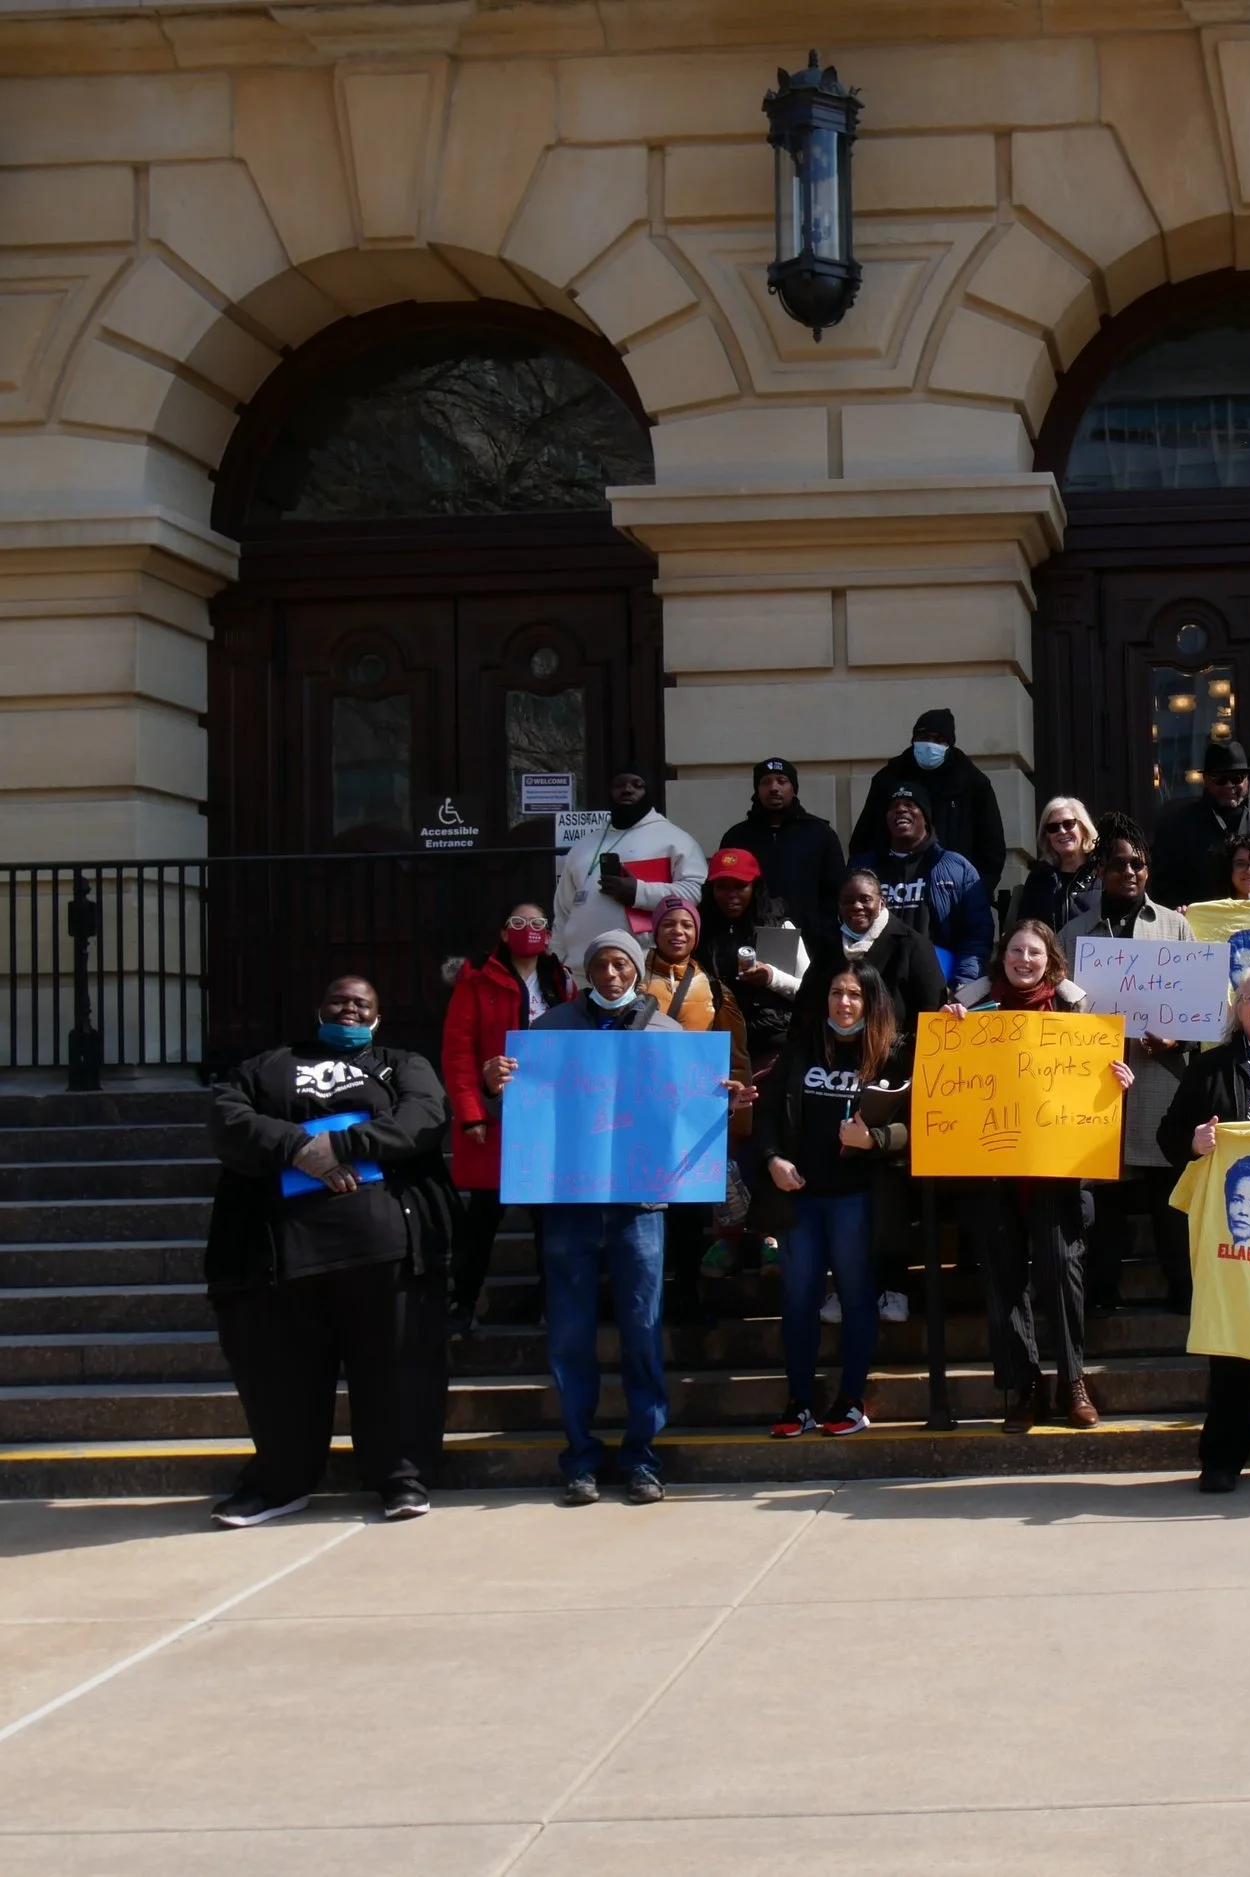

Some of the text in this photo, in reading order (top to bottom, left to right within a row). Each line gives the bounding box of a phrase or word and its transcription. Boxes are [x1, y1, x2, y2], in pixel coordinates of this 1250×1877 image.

[558, 812, 611, 826] ASSISTANC
[420, 826, 479, 836] Accessible
[425, 839, 474, 848] Entrance
[1079, 943, 1215, 974] Party Don't
[1119, 974, 1183, 993] Matter.
[1160, 1001, 1223, 1025] Does!
[922, 1013, 1121, 1056] SB 828 Ensures
[922, 1052, 1092, 1100] Voting Rights
[926, 1110, 960, 1136] For
[982, 1102, 1020, 1133] All
[1217, 1243, 1246, 1260] ELLA
